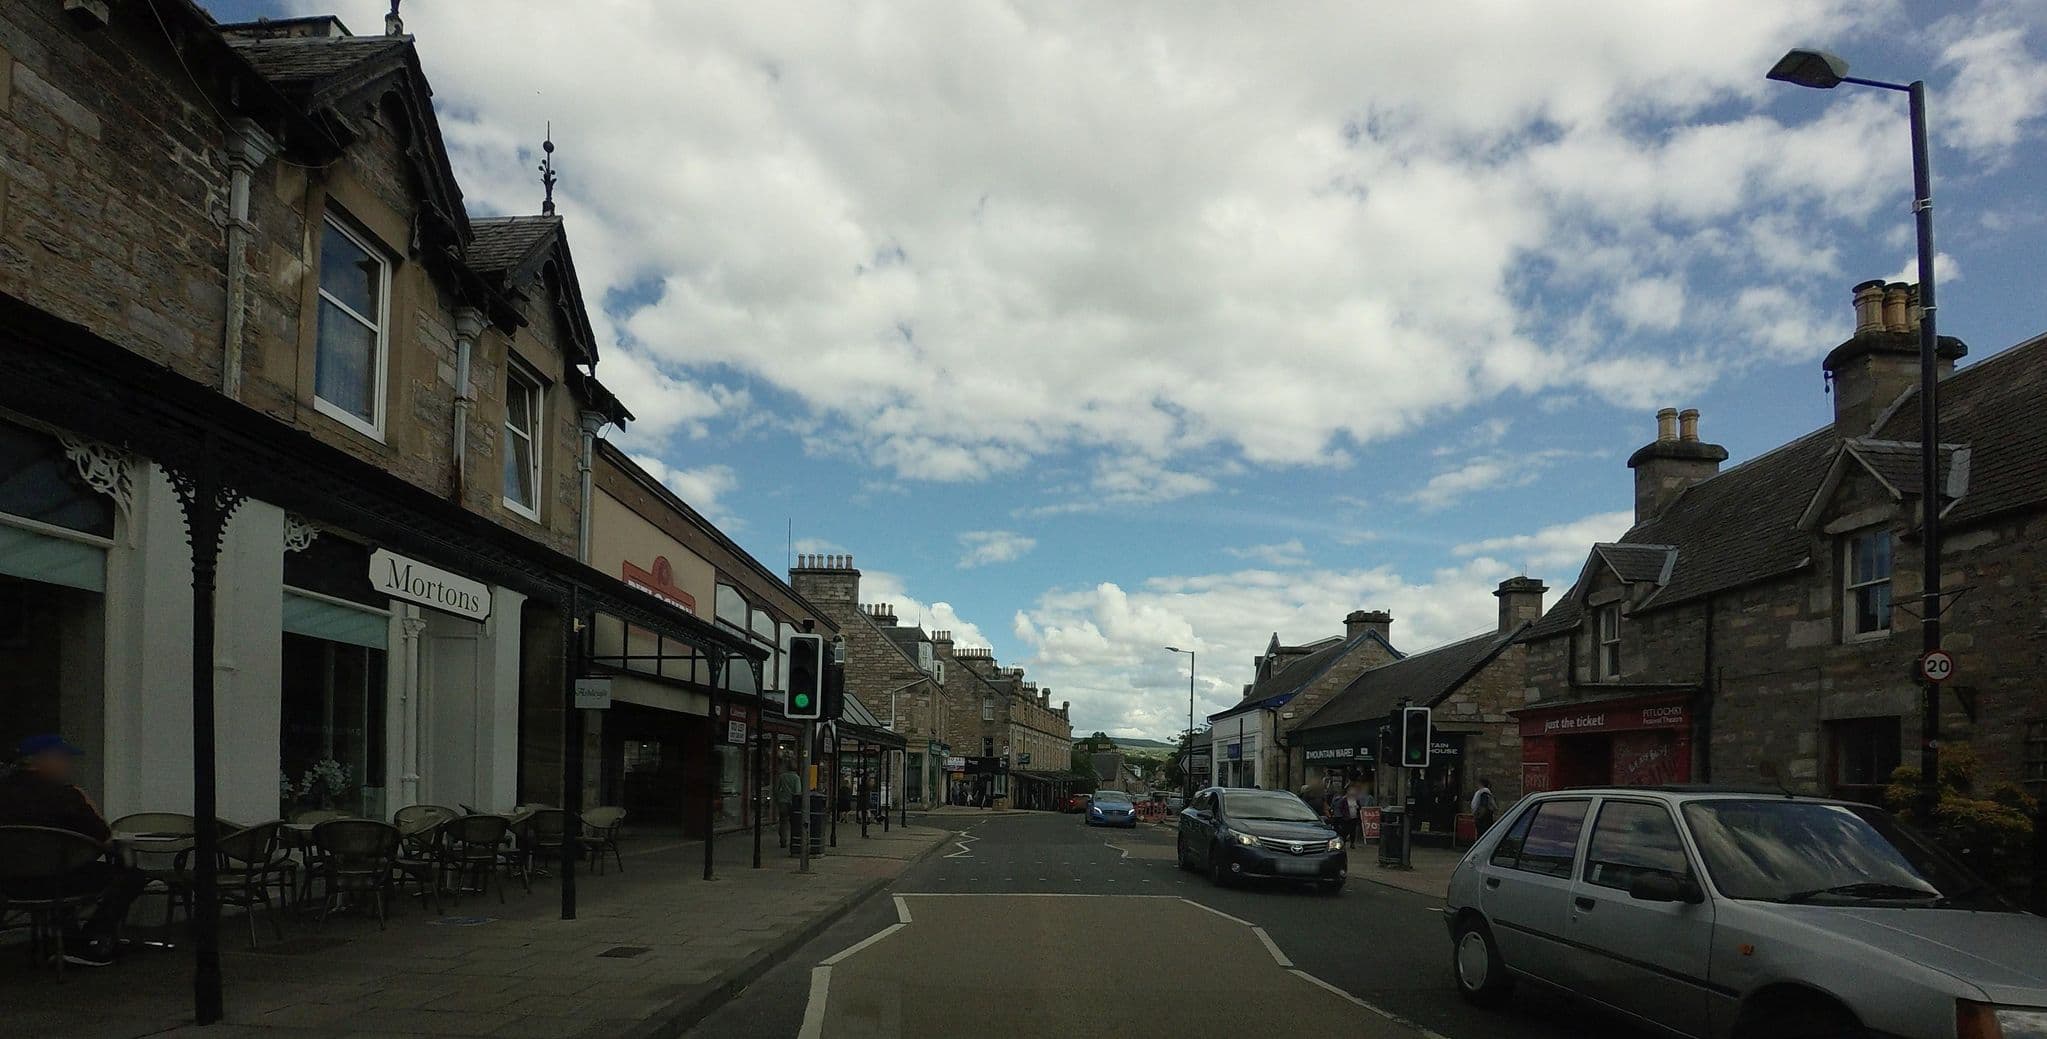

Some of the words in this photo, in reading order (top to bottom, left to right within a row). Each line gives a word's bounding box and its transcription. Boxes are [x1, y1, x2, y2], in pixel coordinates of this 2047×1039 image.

[386, 557, 479, 612] Mortons
[1927, 660, 1949, 673] 20
[1544, 719, 1560, 733] just
[1561, 716, 1575, 728] the
[1577, 713, 1604, 727] ticket!
